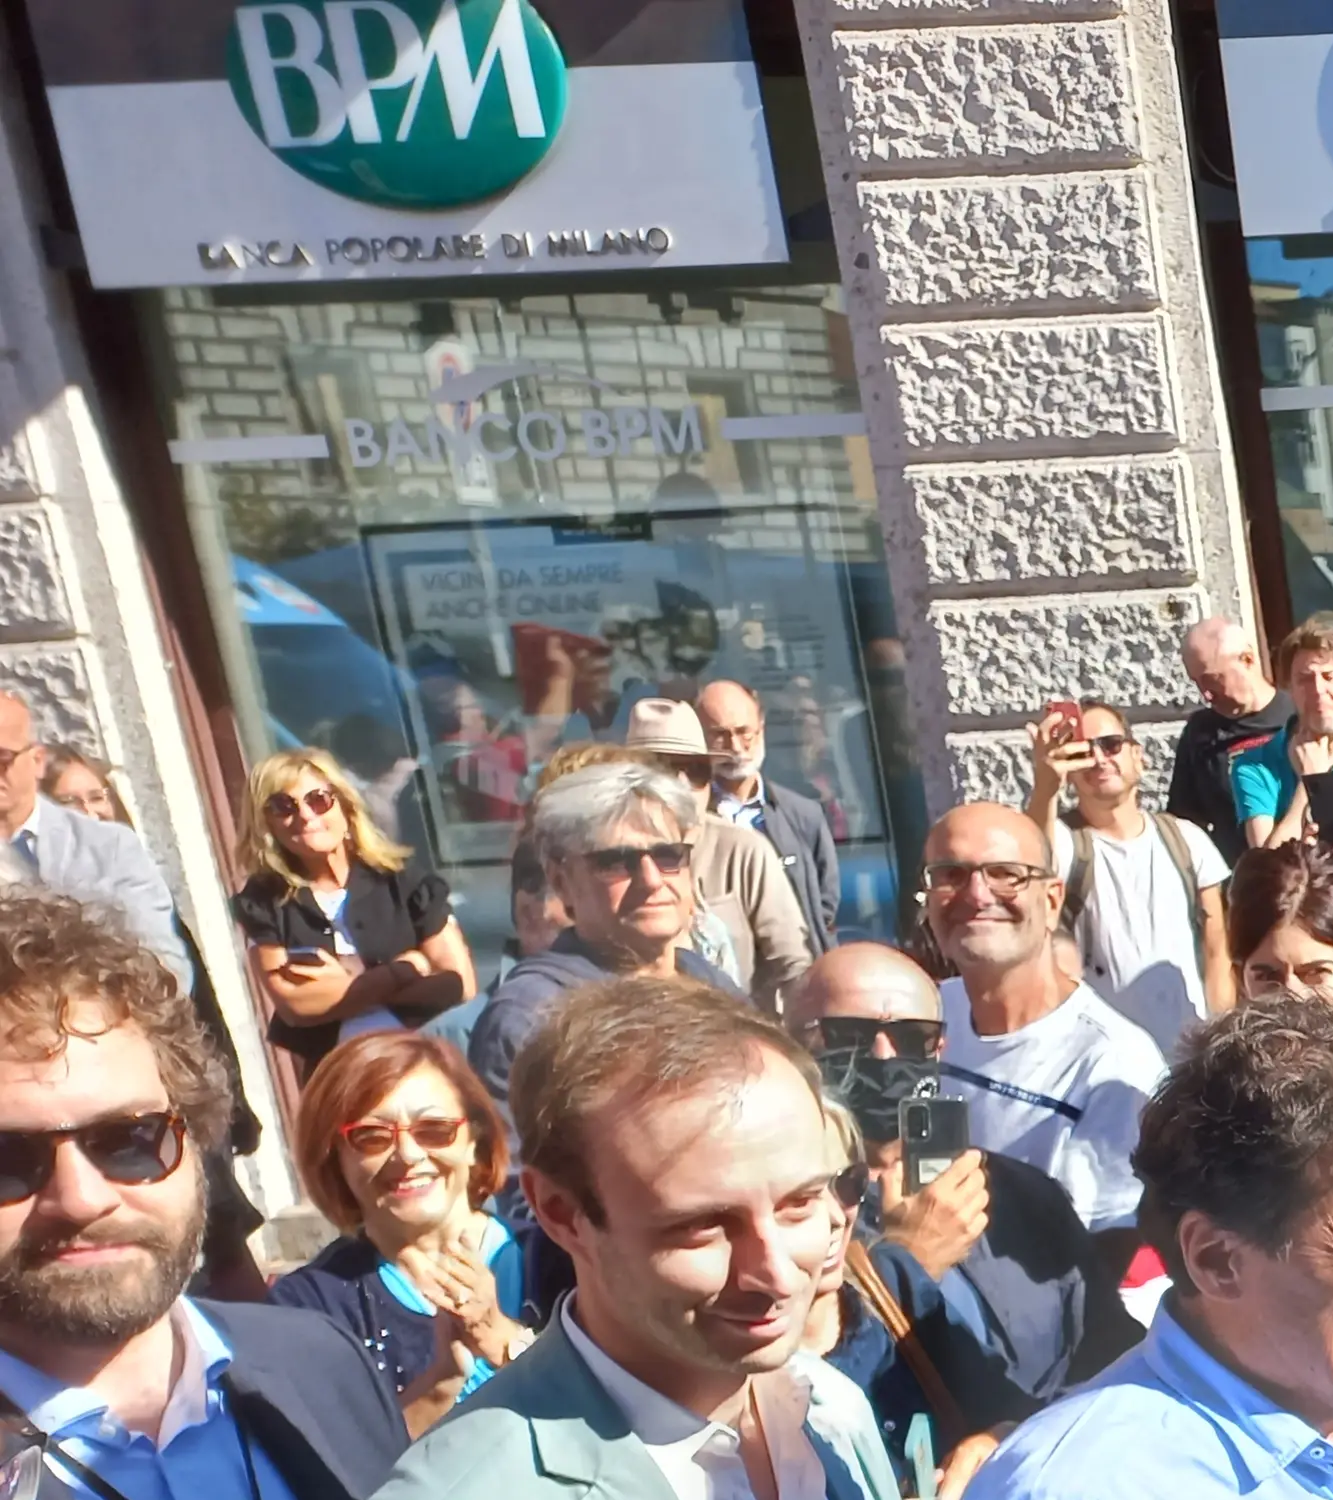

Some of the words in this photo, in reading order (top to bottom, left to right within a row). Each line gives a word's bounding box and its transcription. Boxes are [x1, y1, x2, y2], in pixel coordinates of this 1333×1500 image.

[236, 0, 547, 149] BPM
[198, 241, 311, 270] BANCA
[325, 232, 486, 265] POPOLARE
[502, 231, 534, 258] DI
[547, 226, 672, 257] MILANO
[347, 409, 567, 469] BANCO
[583, 403, 705, 459] BPM
[420, 568, 494, 593] VICIN
[498, 567, 535, 590] DA
[539, 561, 624, 588] SEMPRE
